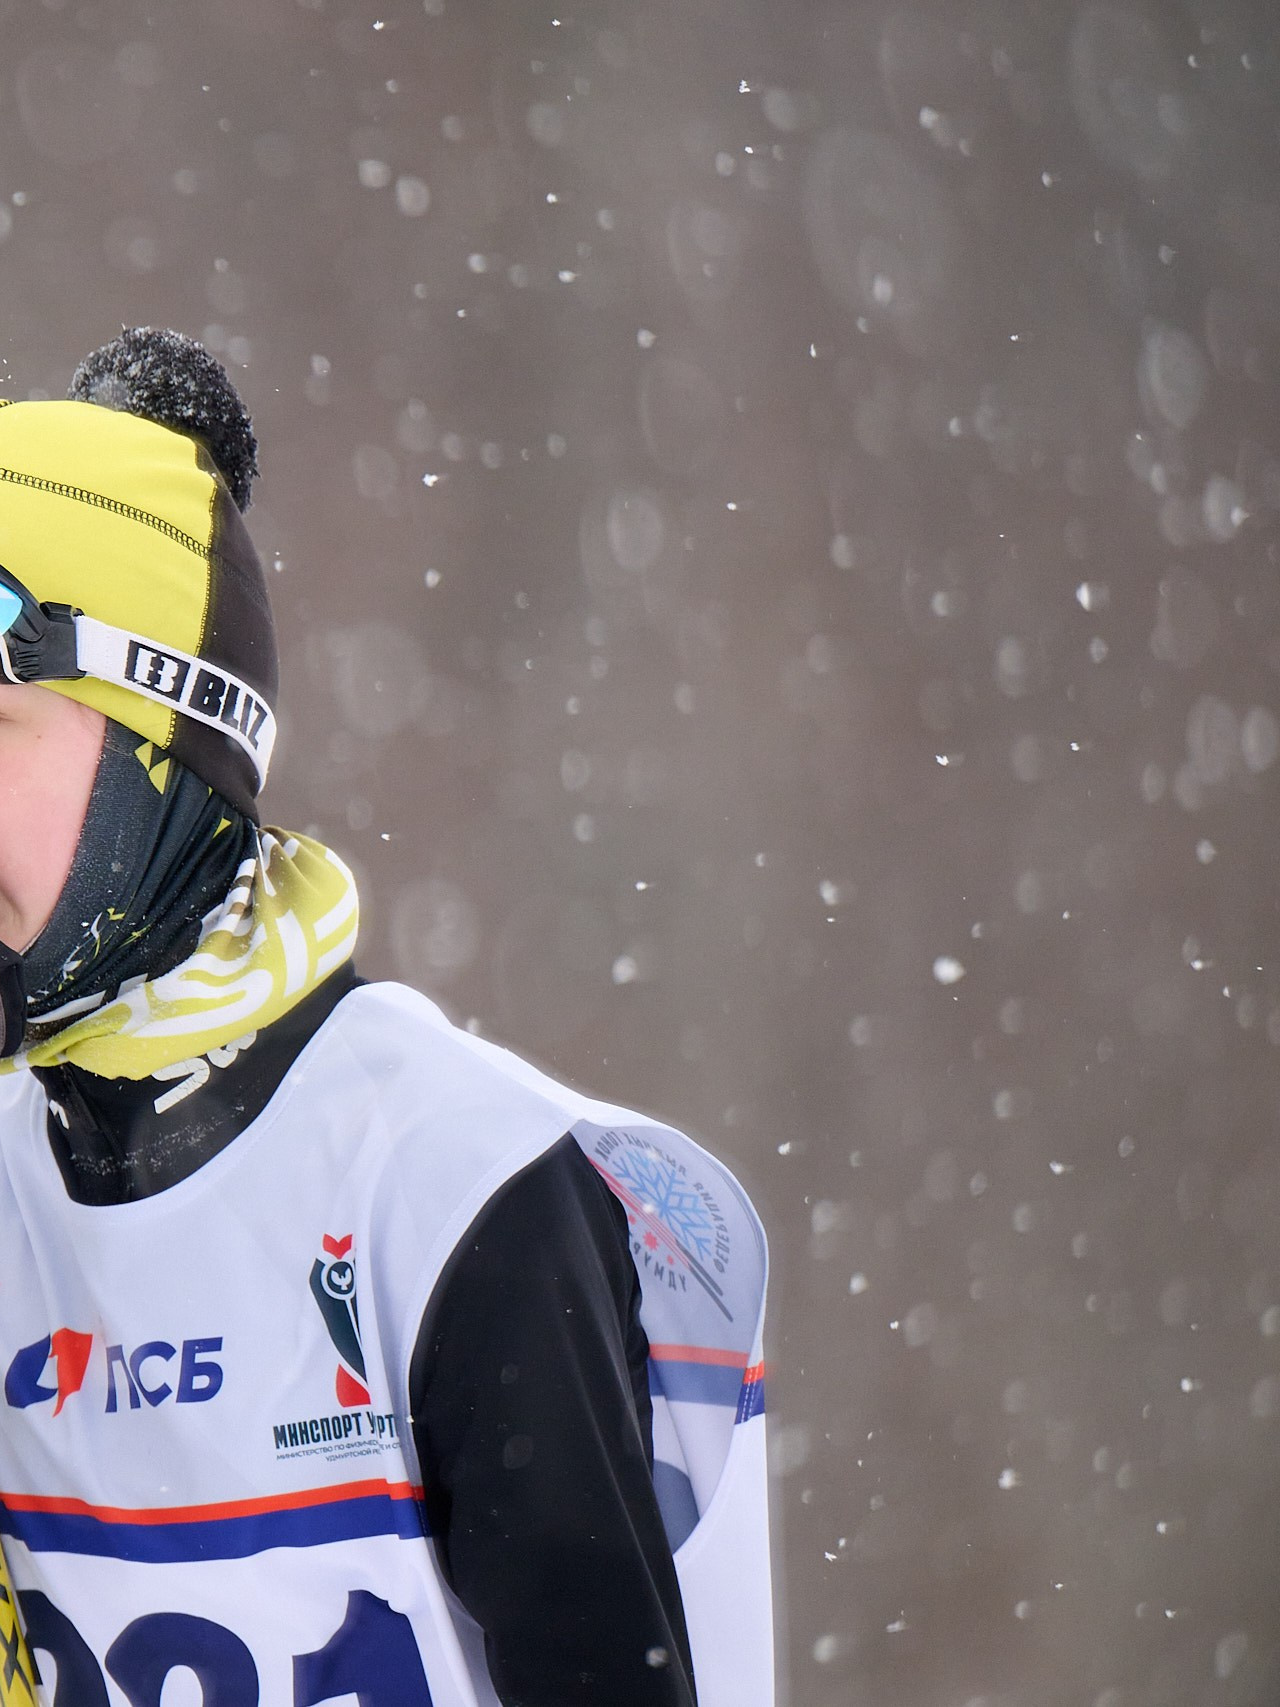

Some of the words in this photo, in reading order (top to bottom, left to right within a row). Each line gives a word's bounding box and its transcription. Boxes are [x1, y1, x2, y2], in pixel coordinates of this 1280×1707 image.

[187, 668, 268, 751] BLIZ
[105, 1336, 224, 1413] ПСБ
[273, 1412, 362, 1449] МИНСПОРТ
[276, 1446, 333, 1460] МИНИСТЕРСТВО
[334, 1444, 345, 1453] ПО
